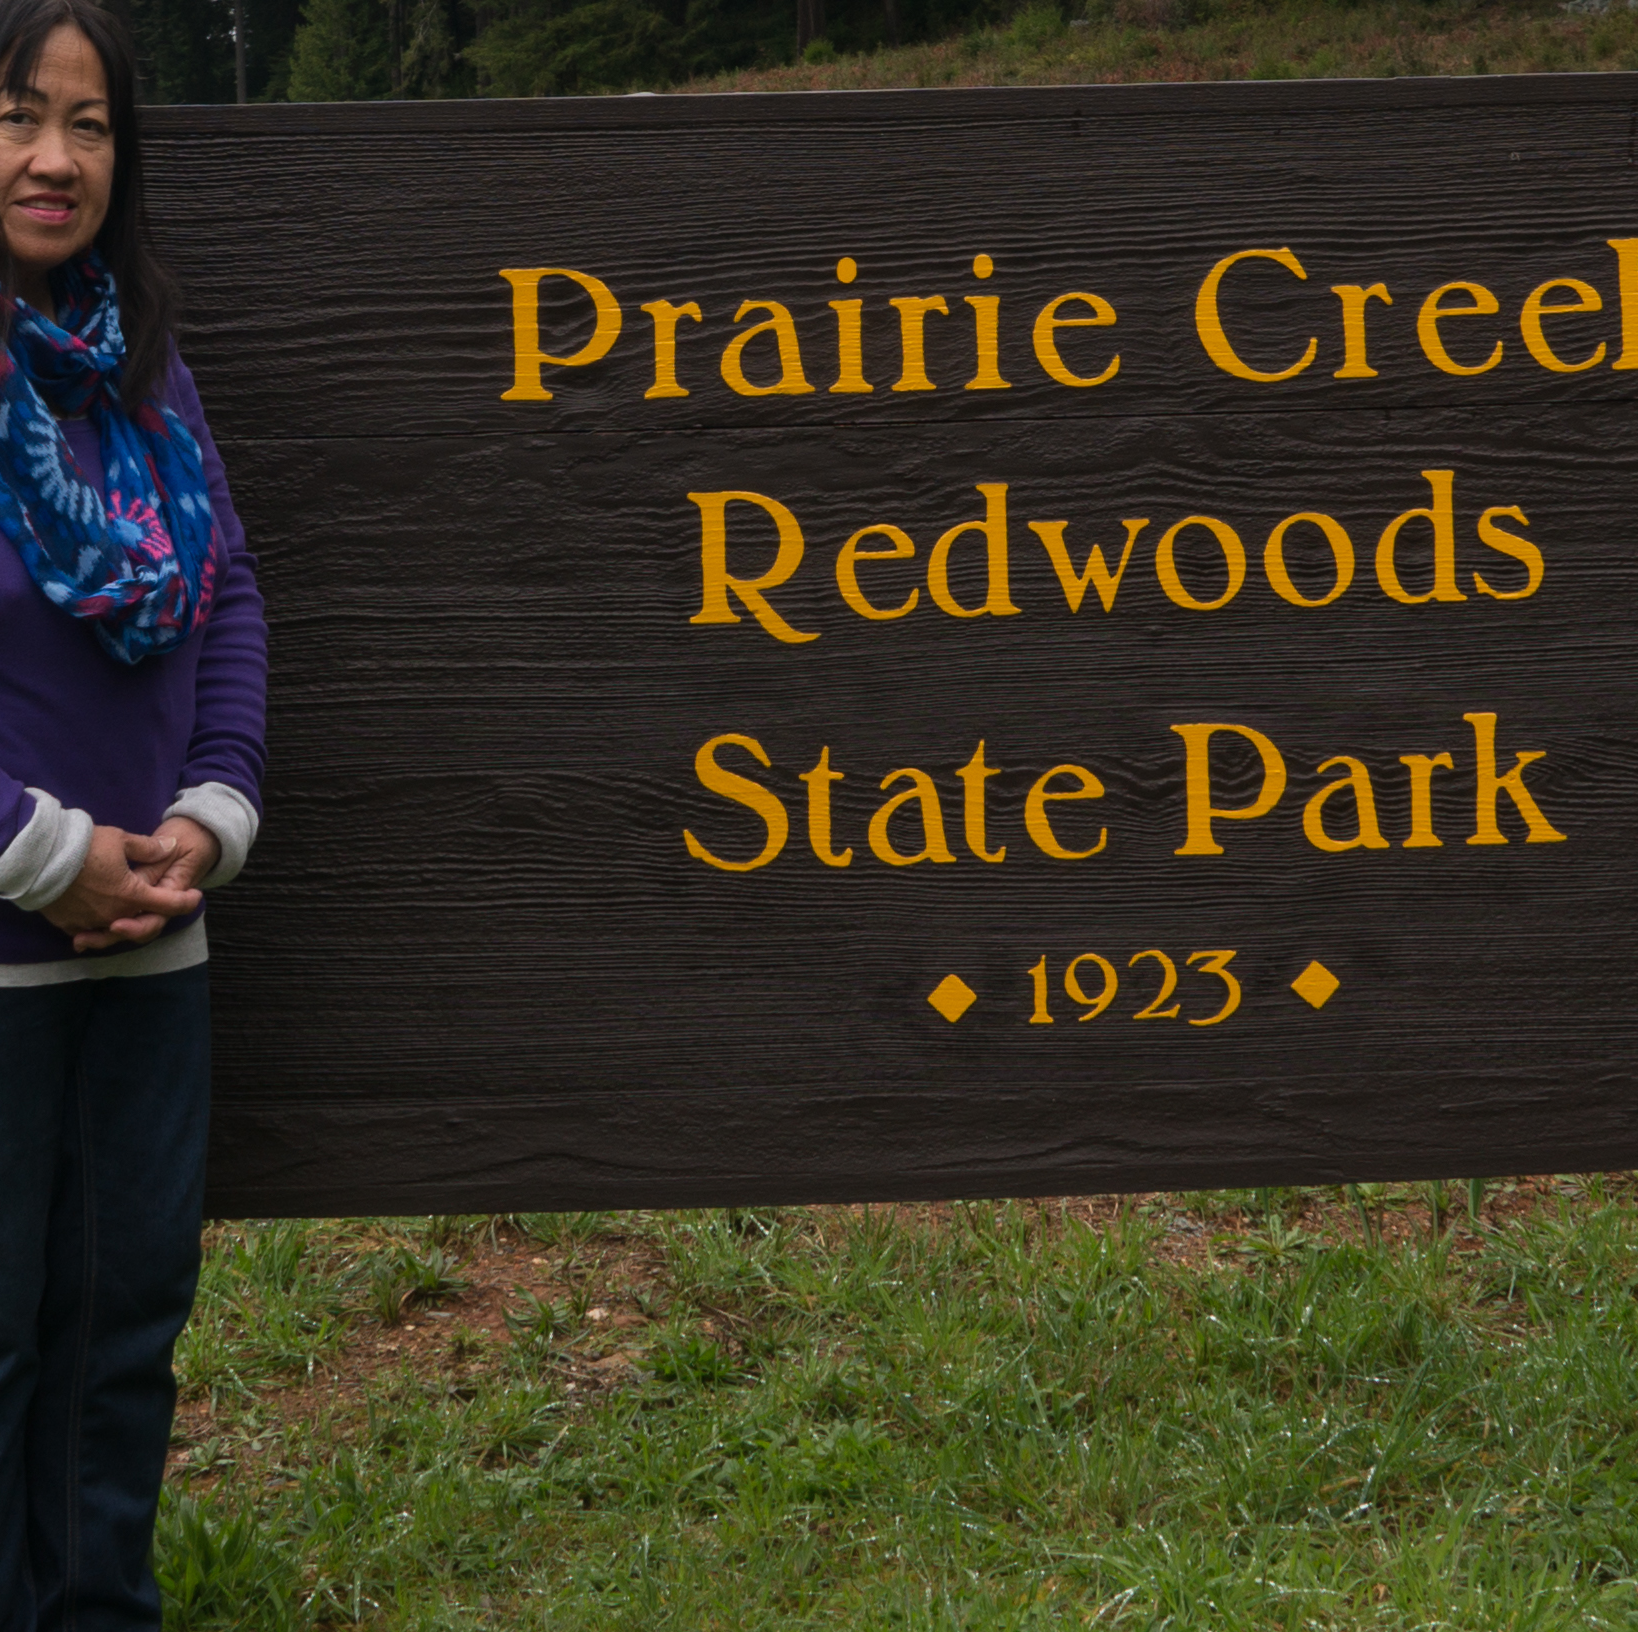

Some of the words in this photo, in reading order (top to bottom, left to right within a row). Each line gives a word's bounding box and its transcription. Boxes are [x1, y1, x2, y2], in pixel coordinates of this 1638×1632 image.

[497, 254, 1122, 402] Prairie
[685, 468, 1546, 645] Redwoods
[681, 731, 1109, 873] State
[1168, 711, 1569, 857] Park
[1026, 948, 1243, 1028] 1923
